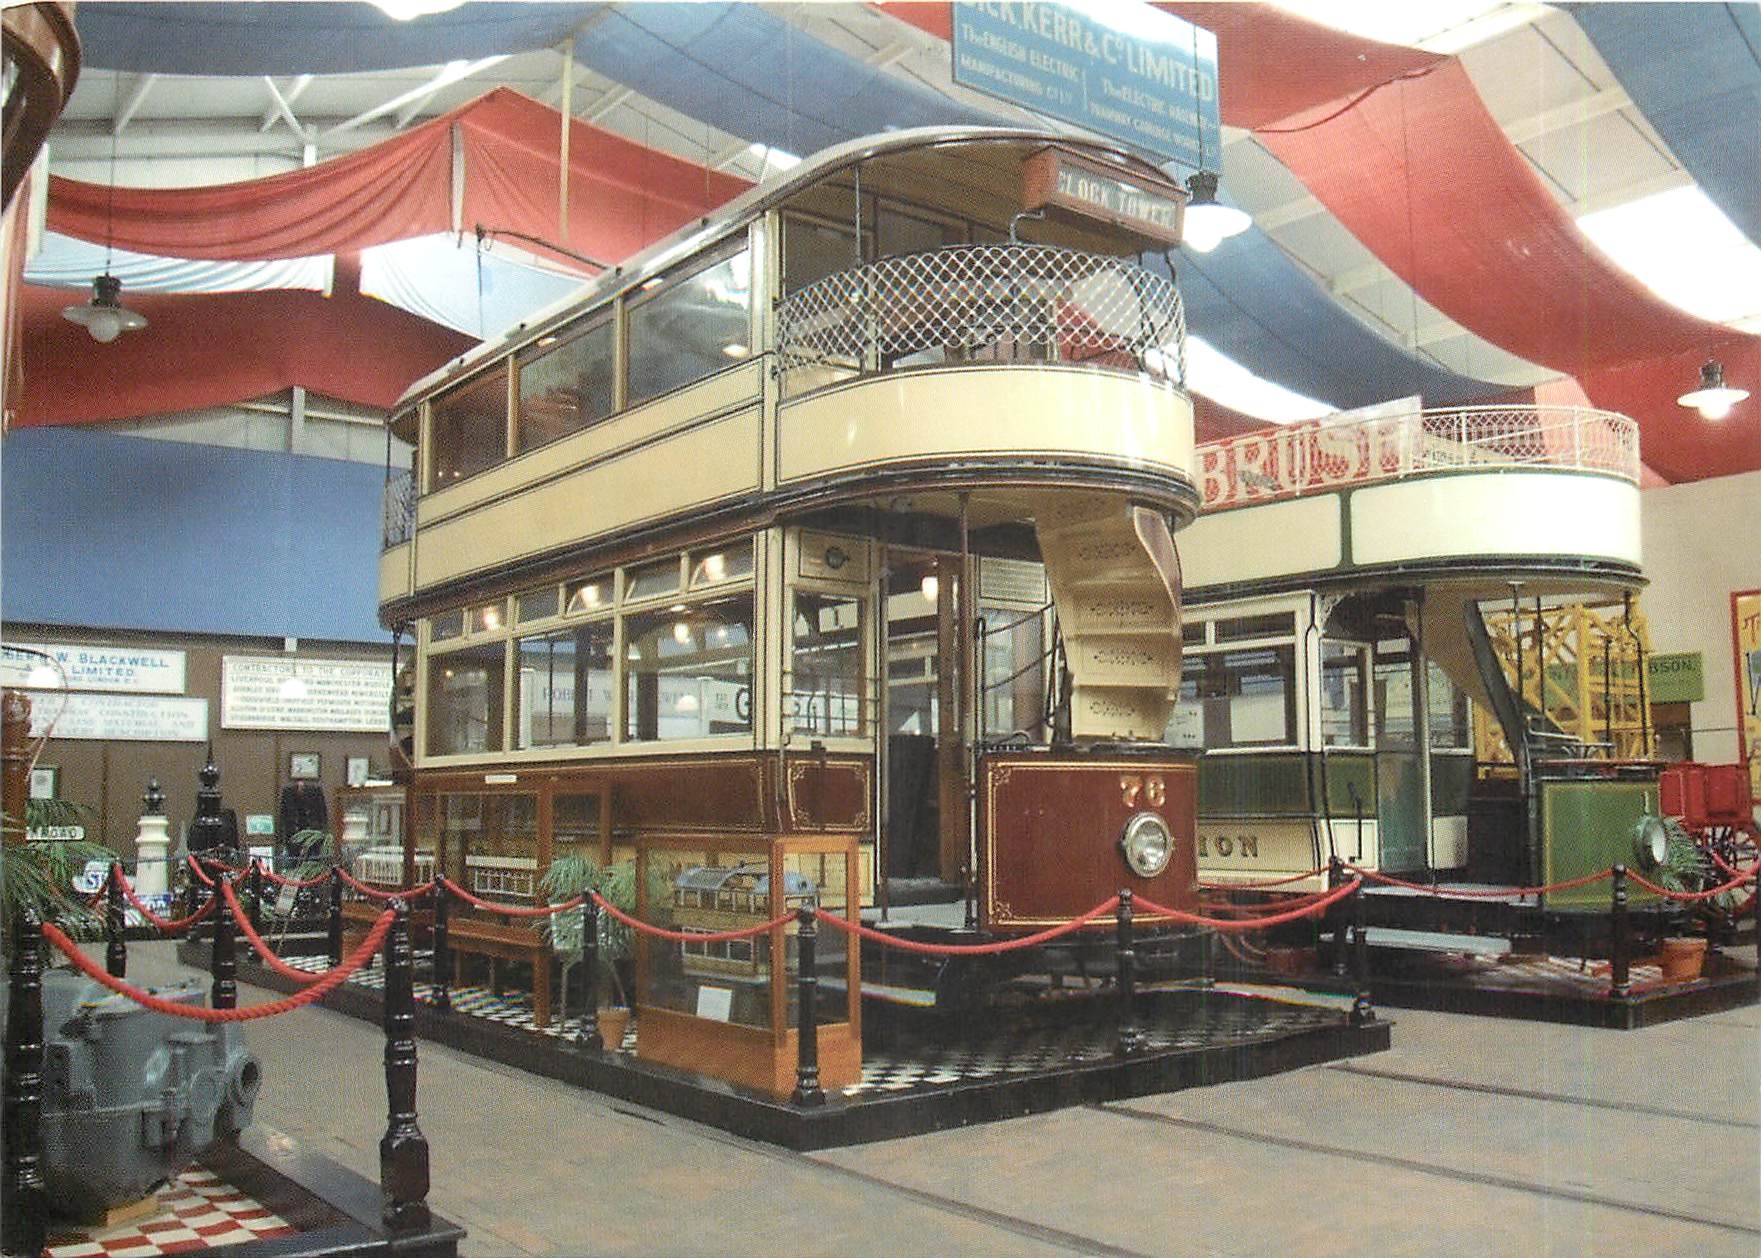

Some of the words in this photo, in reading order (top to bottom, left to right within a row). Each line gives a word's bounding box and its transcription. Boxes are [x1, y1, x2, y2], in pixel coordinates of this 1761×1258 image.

[1126, 41, 1213, 102] LIMITED
[71, 665, 134, 677] LIMITED
[79, 652, 170, 668] BLACKWELL
[1119, 774, 1166, 808] 76
